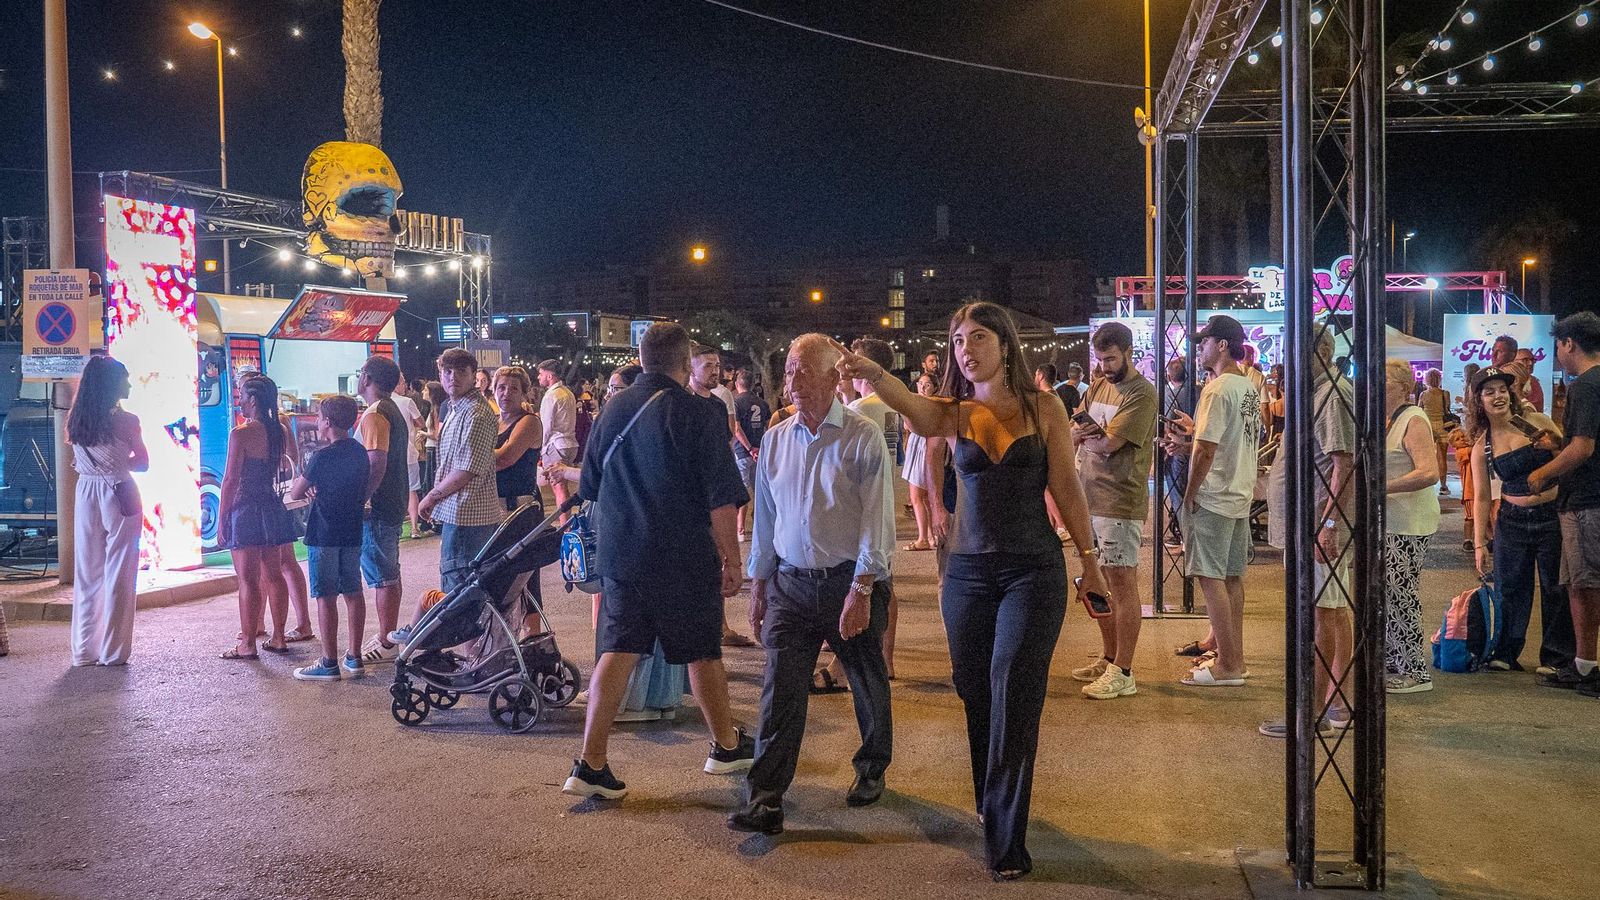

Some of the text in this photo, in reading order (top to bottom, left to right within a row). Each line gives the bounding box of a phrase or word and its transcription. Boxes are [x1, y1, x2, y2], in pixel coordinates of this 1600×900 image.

[59, 275, 77, 283] LOCAL
[29, 283, 59, 291] ROQUETAS
[1270, 291, 1281, 299] DE
[32, 347, 61, 355] RETIRADA
[750, 404, 761, 422] 2
